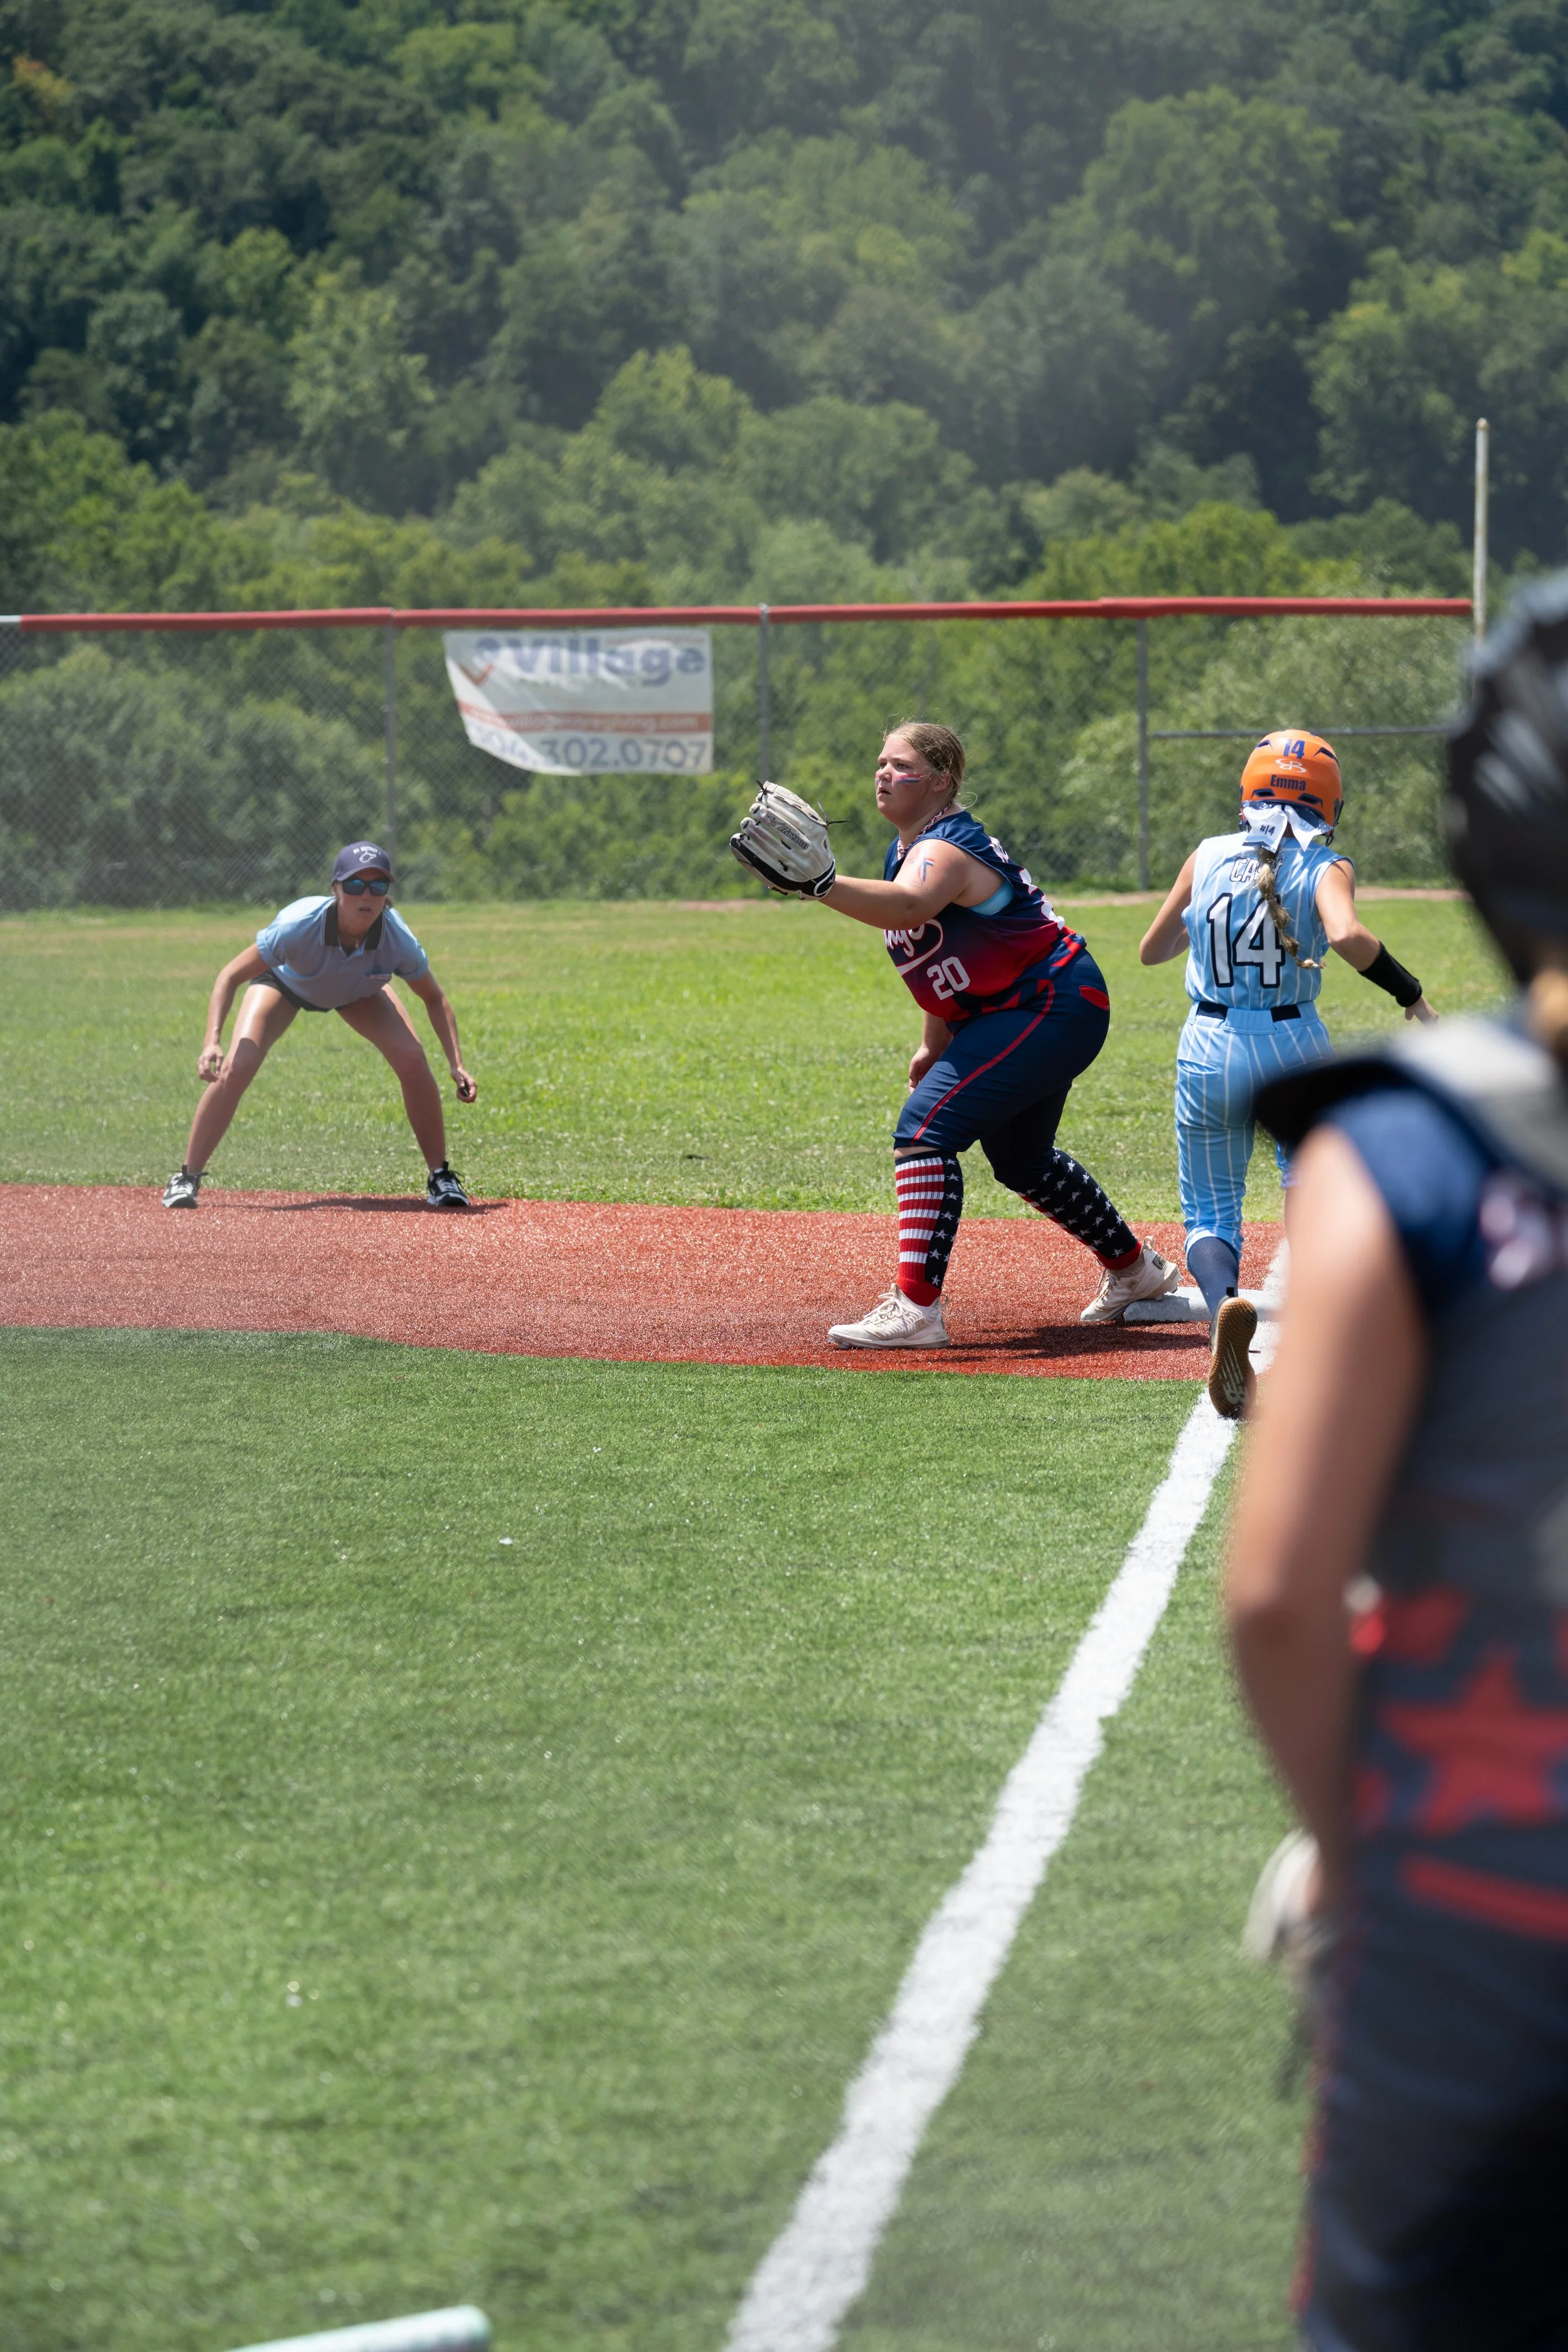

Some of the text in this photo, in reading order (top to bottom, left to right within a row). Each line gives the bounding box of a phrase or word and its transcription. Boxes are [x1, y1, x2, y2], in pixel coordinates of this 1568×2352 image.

[1283, 739, 1306, 759] 14
[1270, 774, 1307, 791] Emma
[1259, 824, 1276, 835] #14
[1206, 893, 1286, 988] 14
[926, 956, 971, 1001] 20
